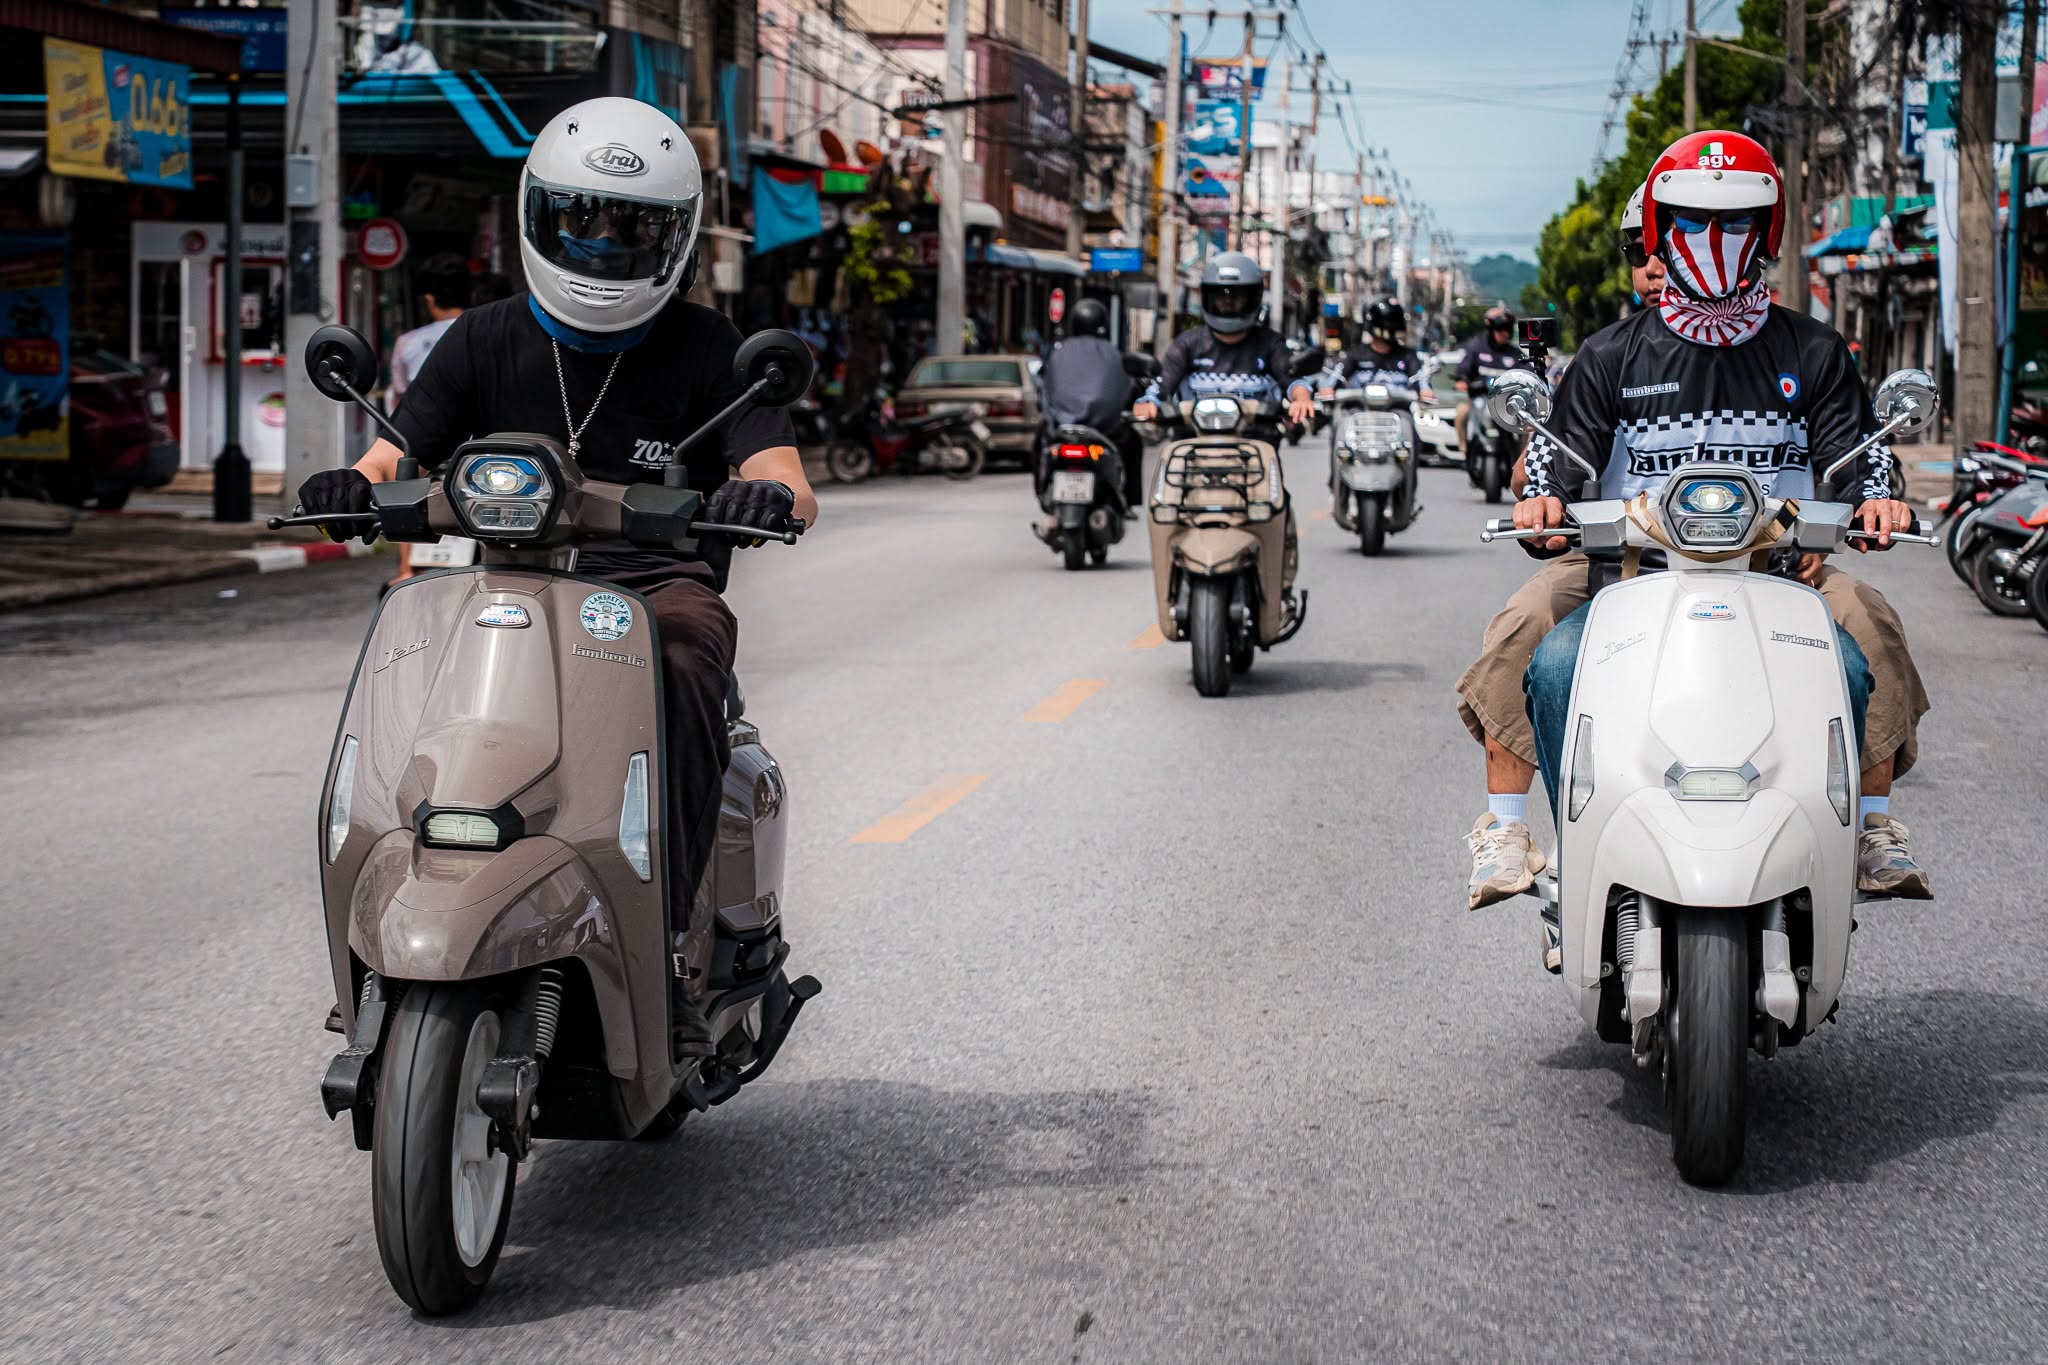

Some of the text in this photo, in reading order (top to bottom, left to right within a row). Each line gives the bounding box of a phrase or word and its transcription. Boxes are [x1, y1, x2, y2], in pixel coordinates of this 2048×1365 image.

[589, 149, 637, 168] Arai
[1698, 154, 1736, 169] agv
[589, 594, 625, 609] LAMBRETTA
